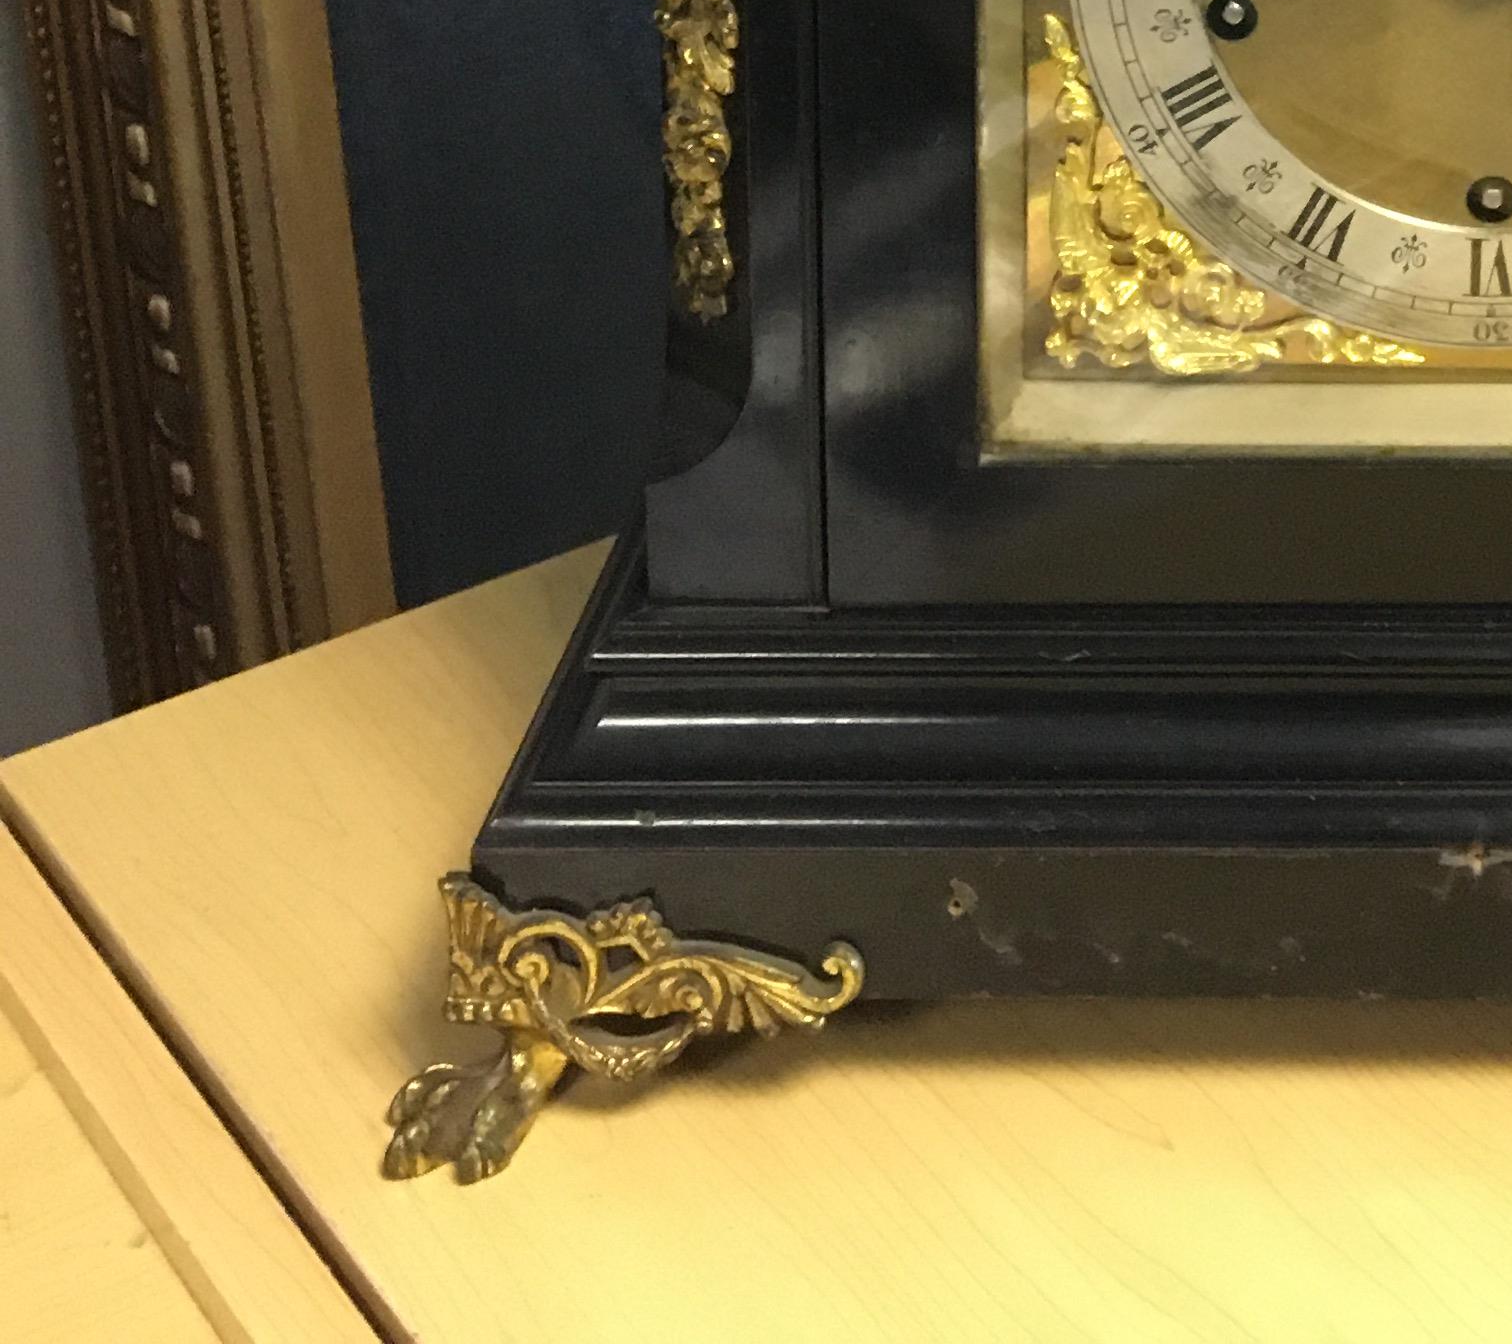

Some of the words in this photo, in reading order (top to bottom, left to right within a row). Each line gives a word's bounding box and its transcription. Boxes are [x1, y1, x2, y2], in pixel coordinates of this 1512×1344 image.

[1154, 60, 1242, 150] VIII
[1128, 123, 1160, 157] 40
[1280, 181, 1356, 267] VII
[1473, 319, 1510, 343] 30
